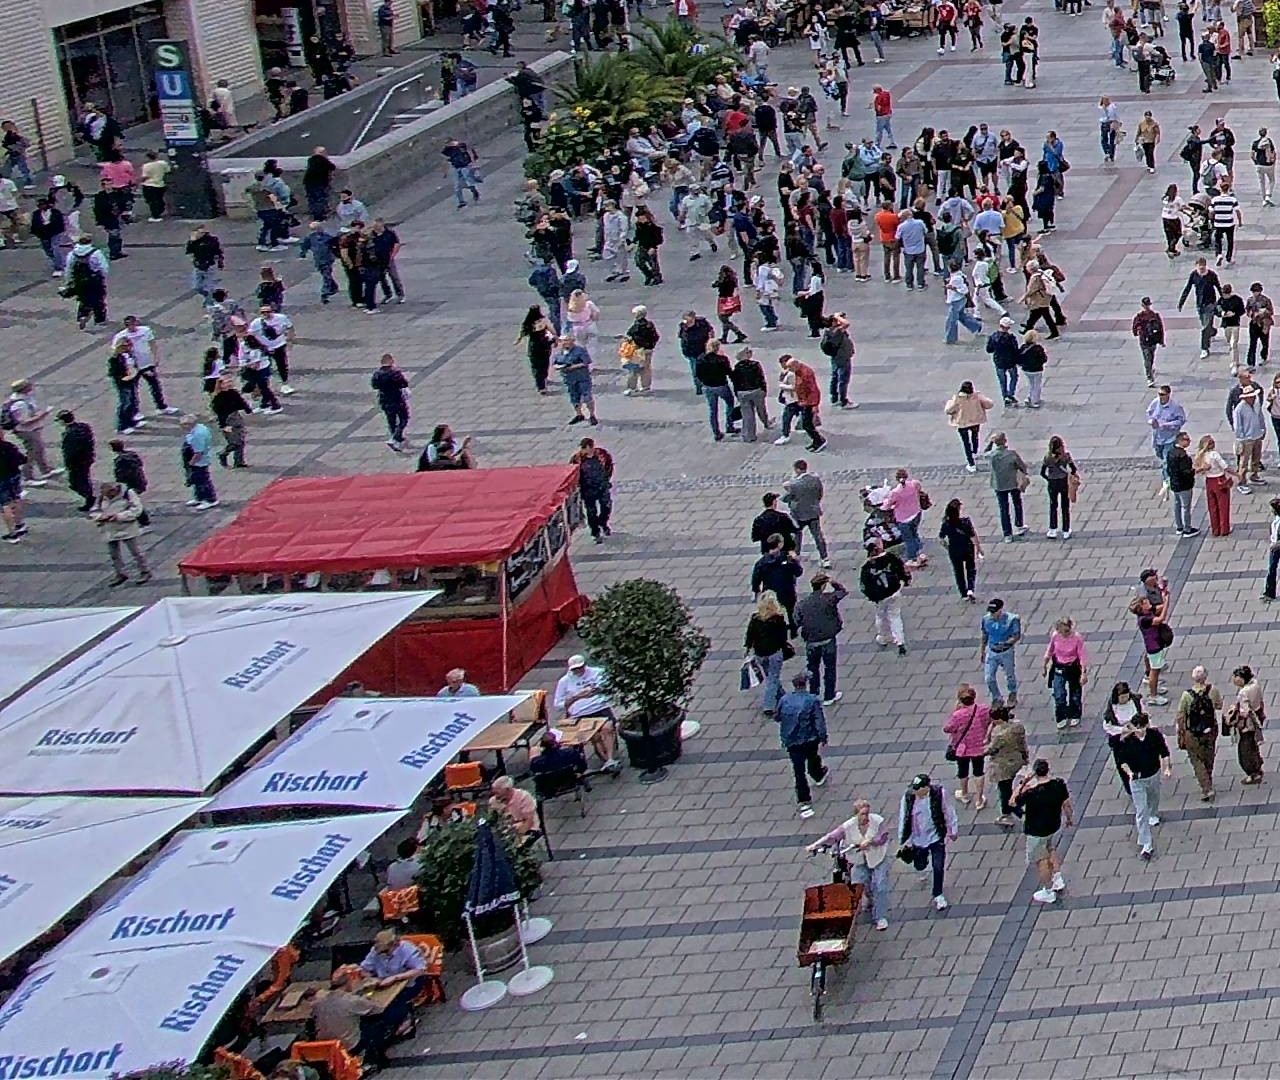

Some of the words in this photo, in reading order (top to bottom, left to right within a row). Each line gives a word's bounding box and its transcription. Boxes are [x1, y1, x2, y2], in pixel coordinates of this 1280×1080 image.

[157, 44, 180, 68] S
[163, 74, 183, 96] U
[222, 638, 298, 690] Rischart
[36, 725, 139, 747] Rischart
[399, 710, 477, 770] Rischart
[261, 770, 369, 794] Rischart
[271, 832, 352, 901] Rischart
[109, 907, 236, 941] Rischart
[159, 952, 245, 1033] Rischart
